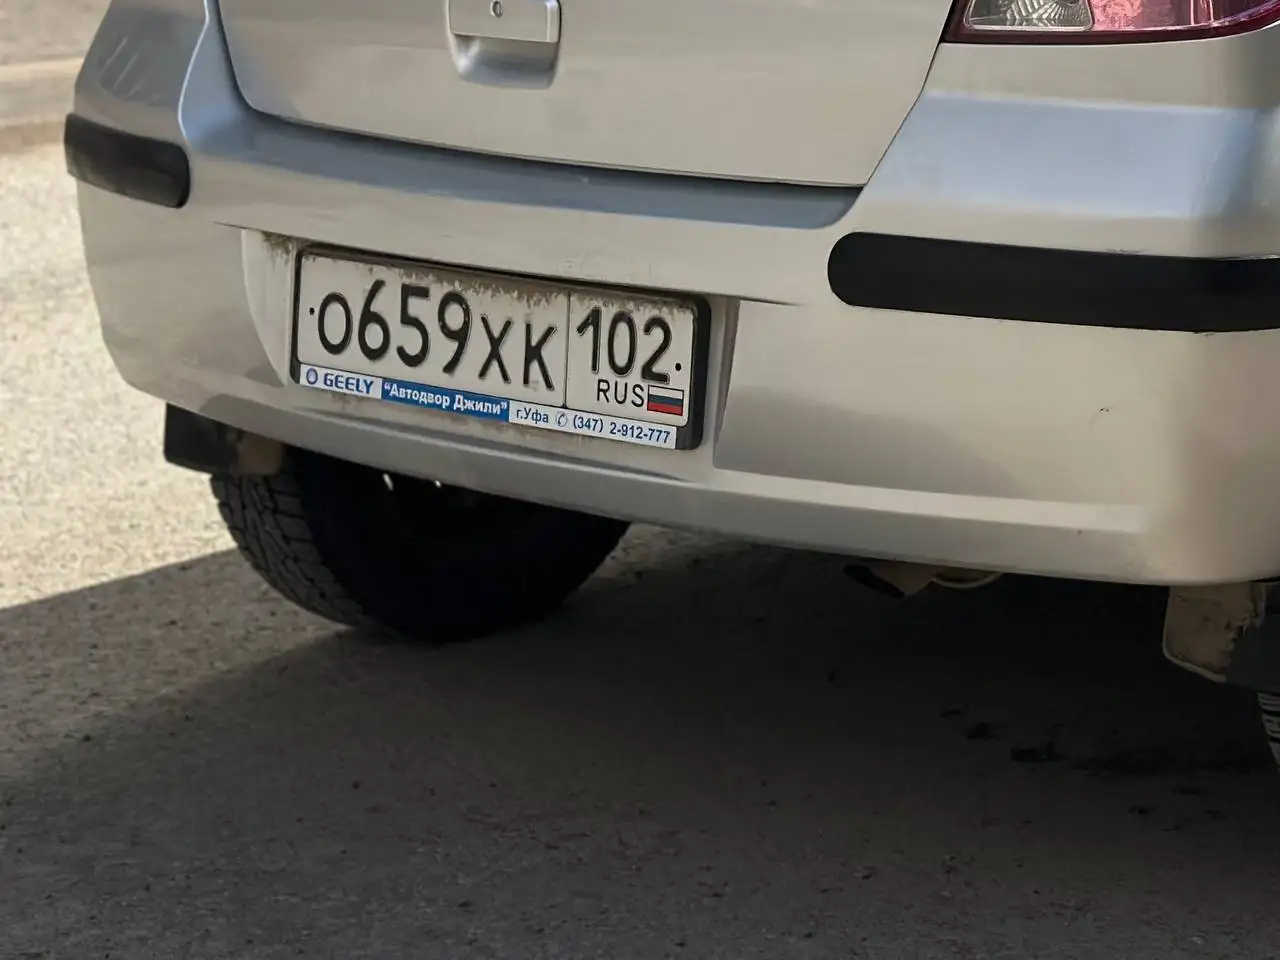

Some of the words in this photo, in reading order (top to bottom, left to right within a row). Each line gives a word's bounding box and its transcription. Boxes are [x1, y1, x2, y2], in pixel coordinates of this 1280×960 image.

[576, 306, 672, 384] 102
[323, 372, 374, 395] GEELY
[596, 378, 645, 408] RUS
[573, 414, 604, 434] (347)
[609, 421, 671, 444] 2-912-777
